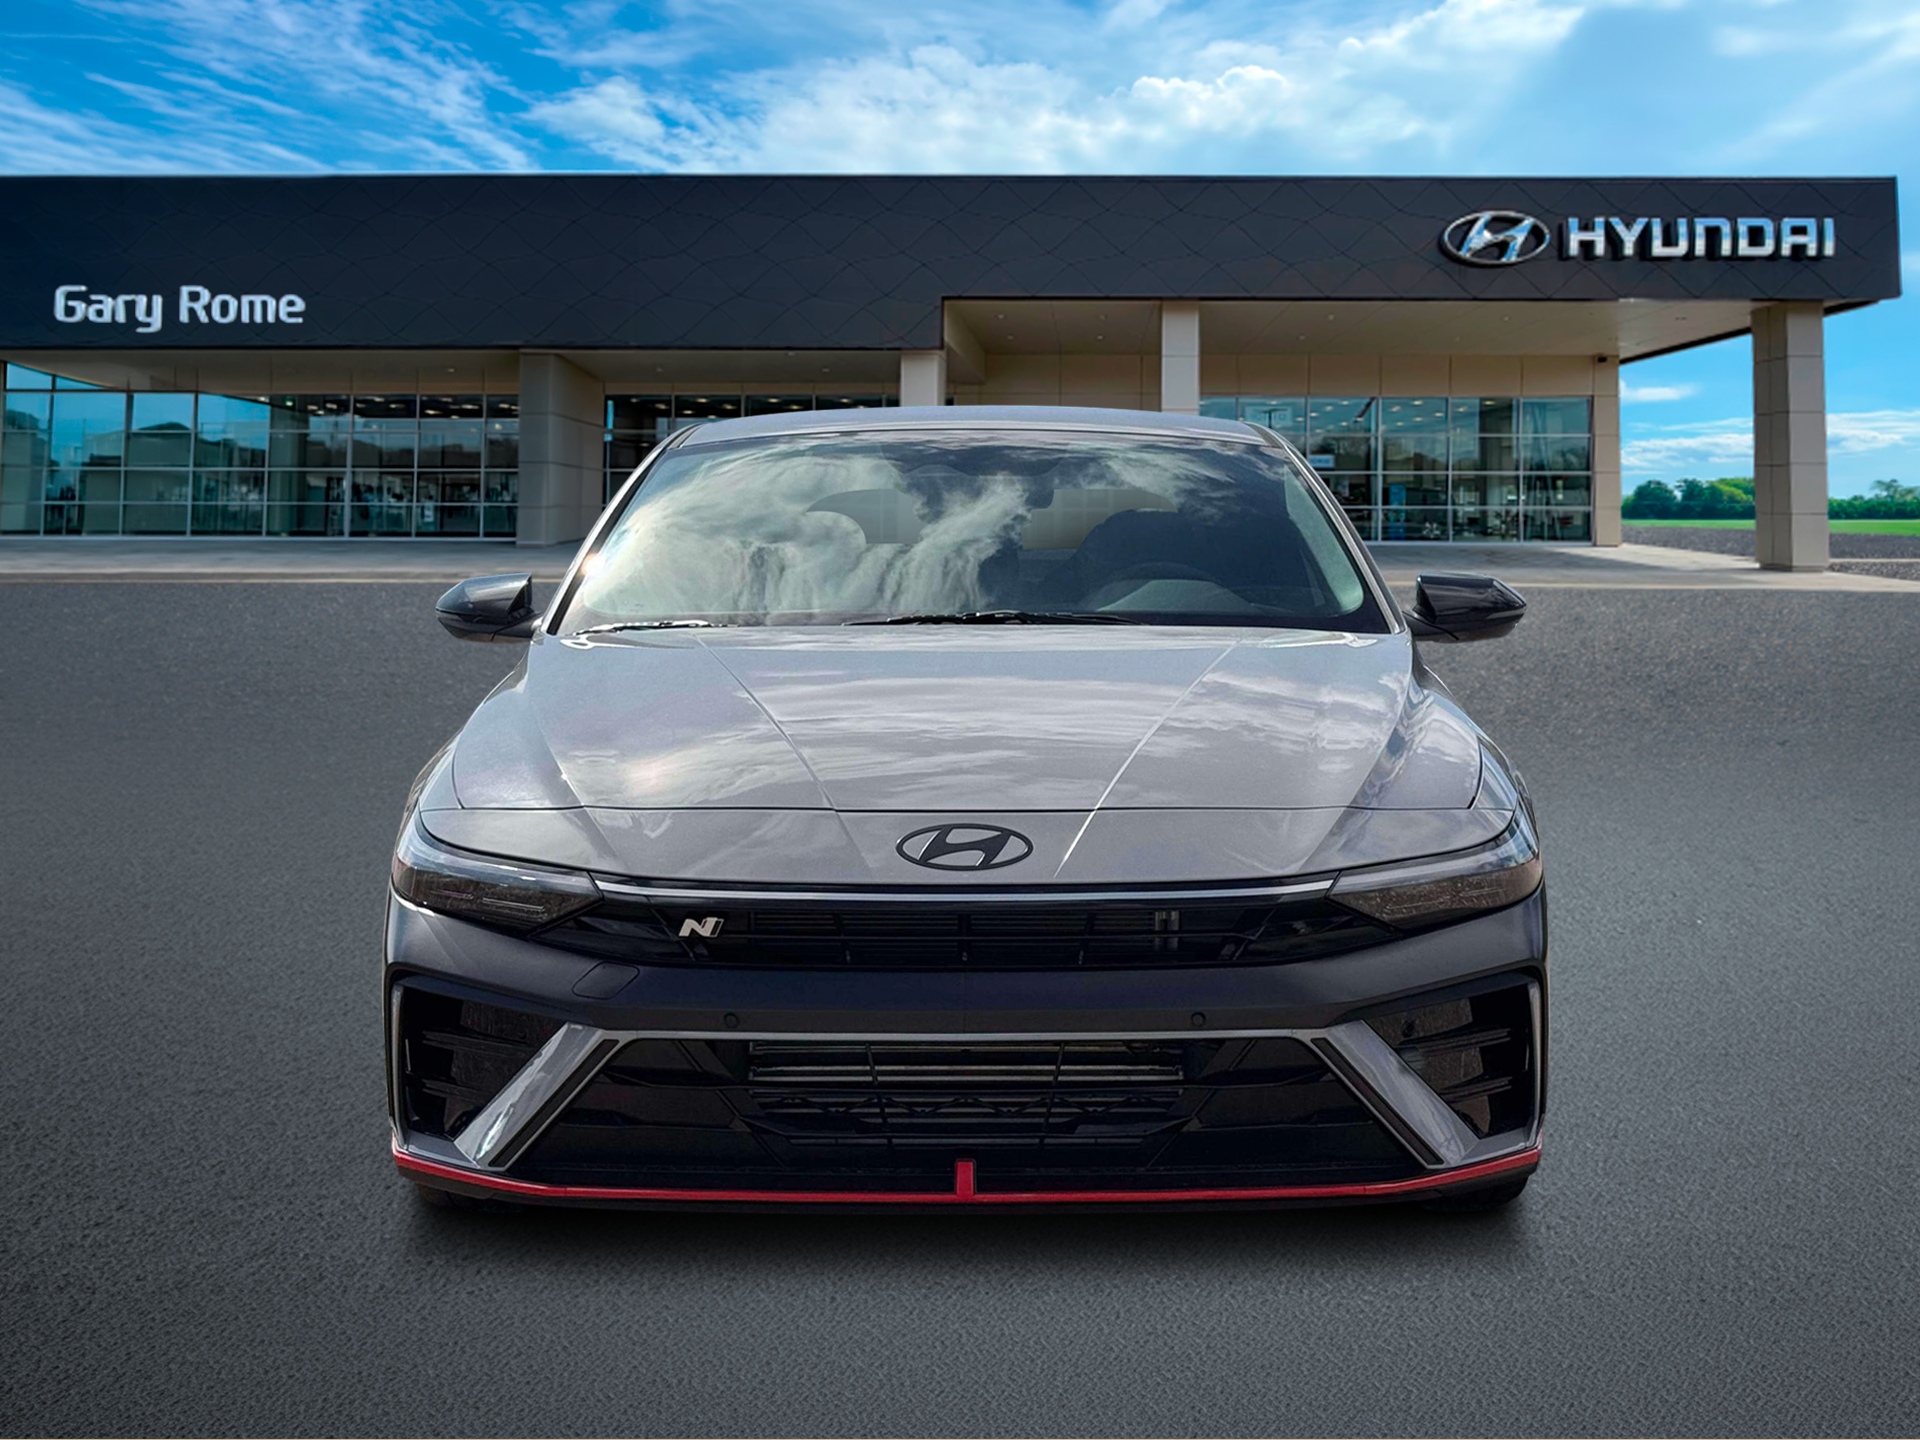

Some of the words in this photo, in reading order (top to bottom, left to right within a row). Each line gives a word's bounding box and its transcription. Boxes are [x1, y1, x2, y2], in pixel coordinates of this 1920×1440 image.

[1567, 217, 1836, 257] HYUNDAI
[54, 284, 163, 333] Gary
[179, 284, 306, 324] Rome
